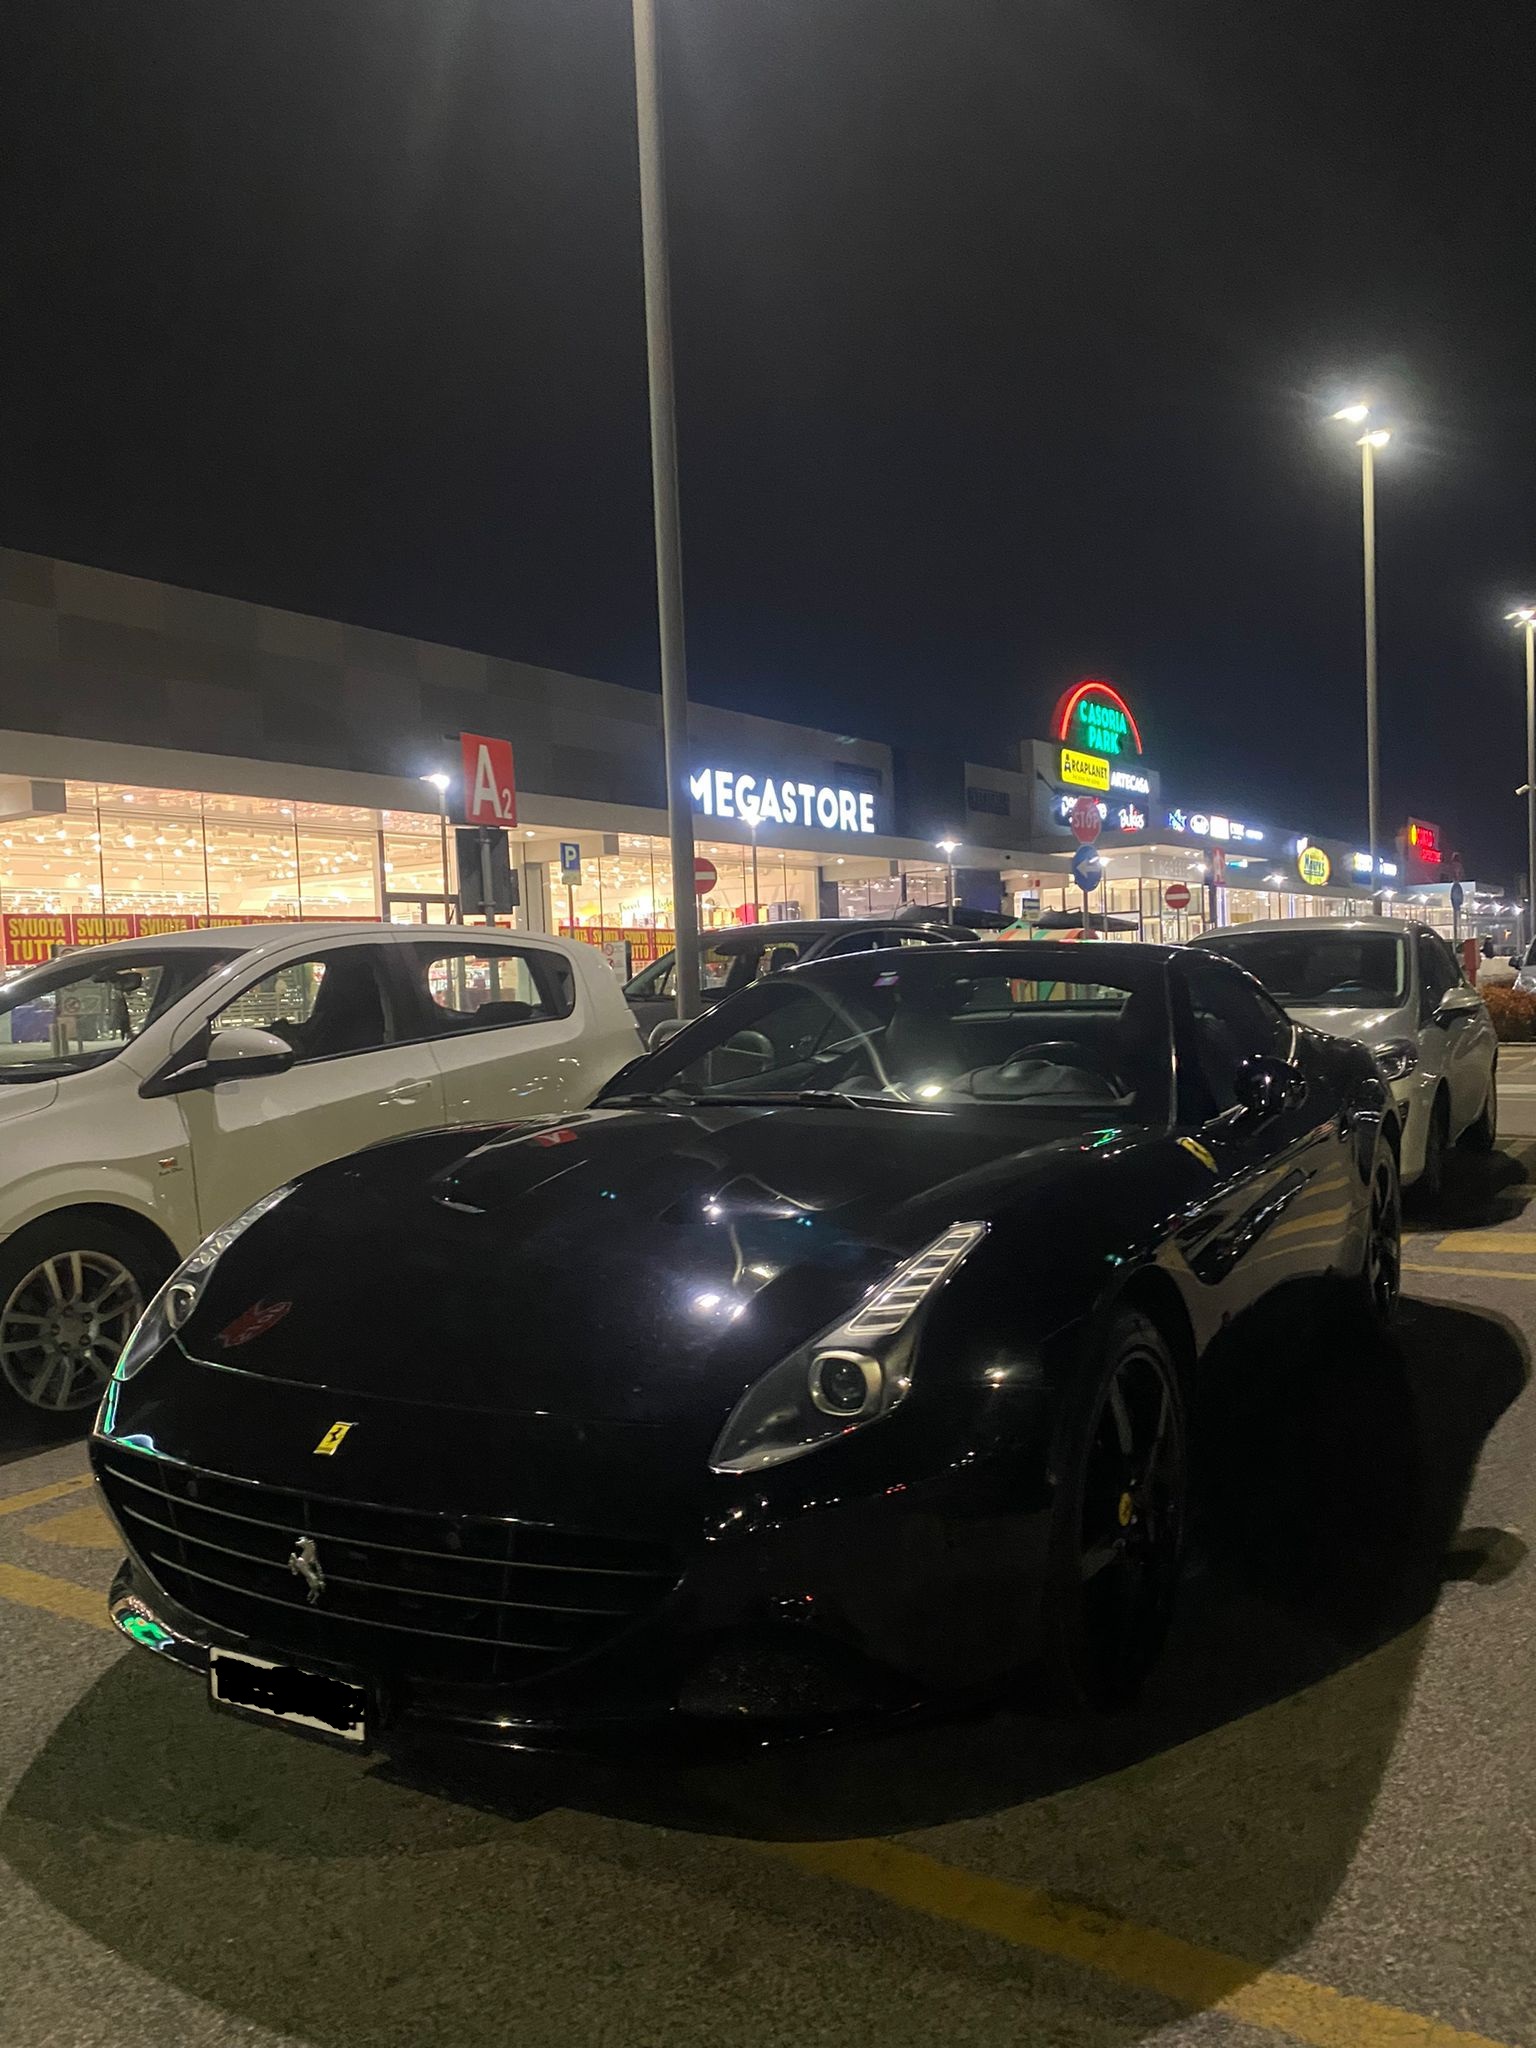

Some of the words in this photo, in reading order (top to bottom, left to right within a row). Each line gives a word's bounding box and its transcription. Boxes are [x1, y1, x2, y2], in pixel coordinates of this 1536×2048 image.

[1079, 700, 1128, 735] CASORIA
[1088, 725, 1120, 755] PARK
[1064, 754, 1108, 779] ARCAPLANET
[690, 768, 875, 833] MEGASTORE
[1073, 811, 1100, 829] STOP
[565, 845, 577, 868] P
[9, 918, 66, 937] SVUOTA
[77, 918, 129, 938] SVUOTA
[11, 940, 66, 961] TUTT
